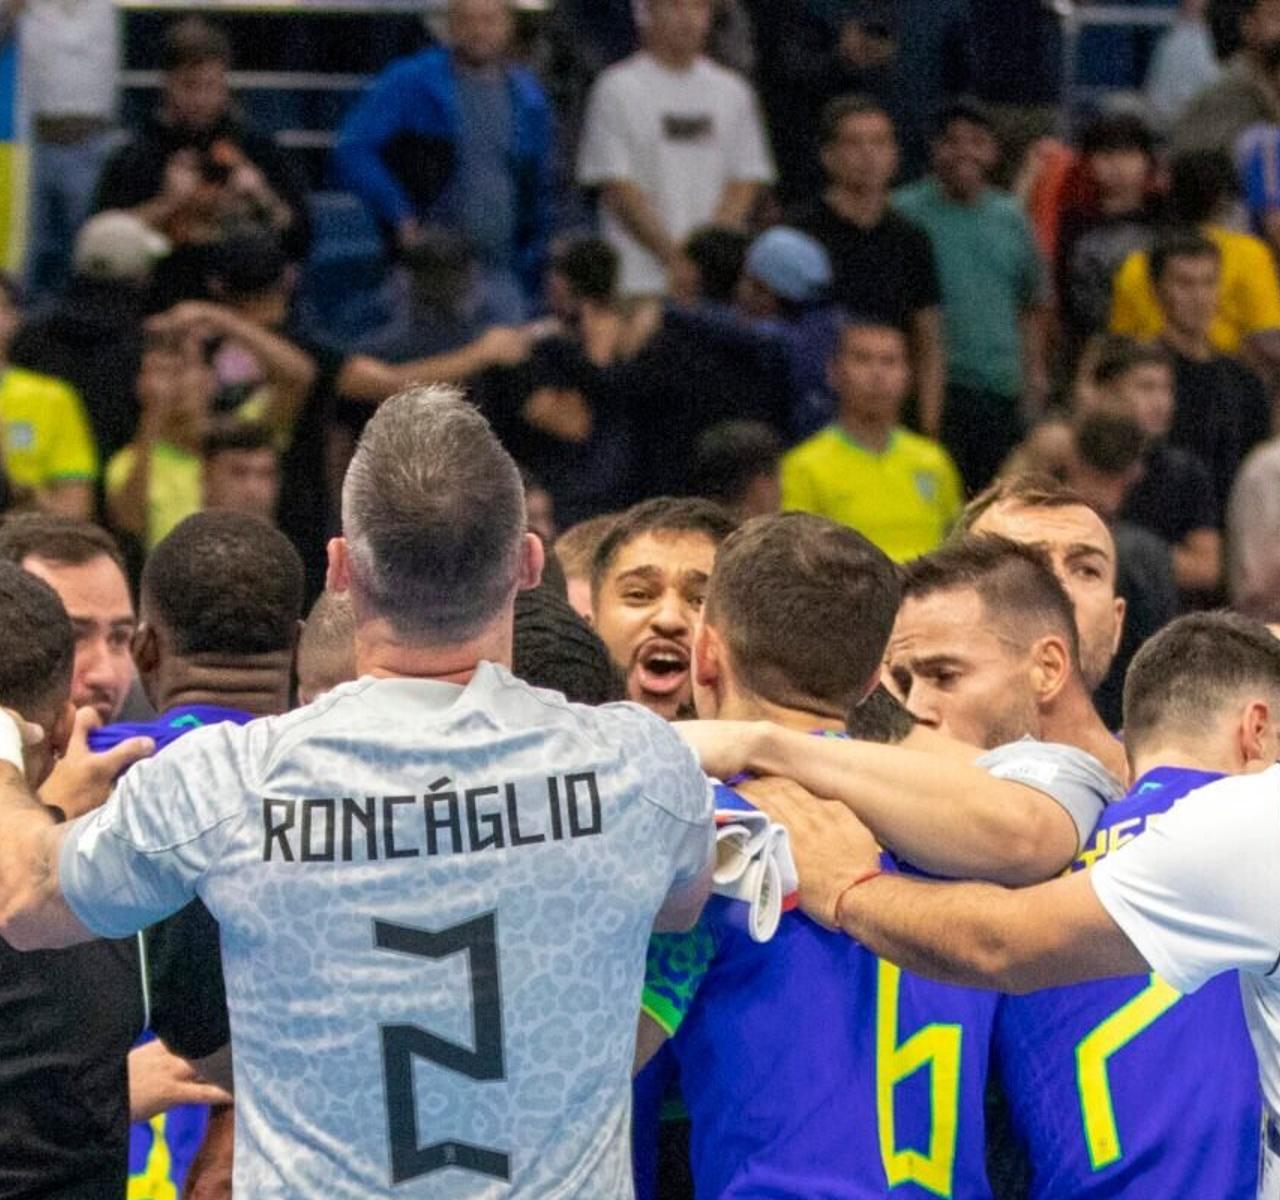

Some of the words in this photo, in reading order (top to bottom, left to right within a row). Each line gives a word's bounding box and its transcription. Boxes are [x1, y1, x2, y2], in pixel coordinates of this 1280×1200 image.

[263, 772, 602, 862] RONCÁGLIO
[371, 907, 513, 1187] 2
[876, 957, 962, 1200] 6
